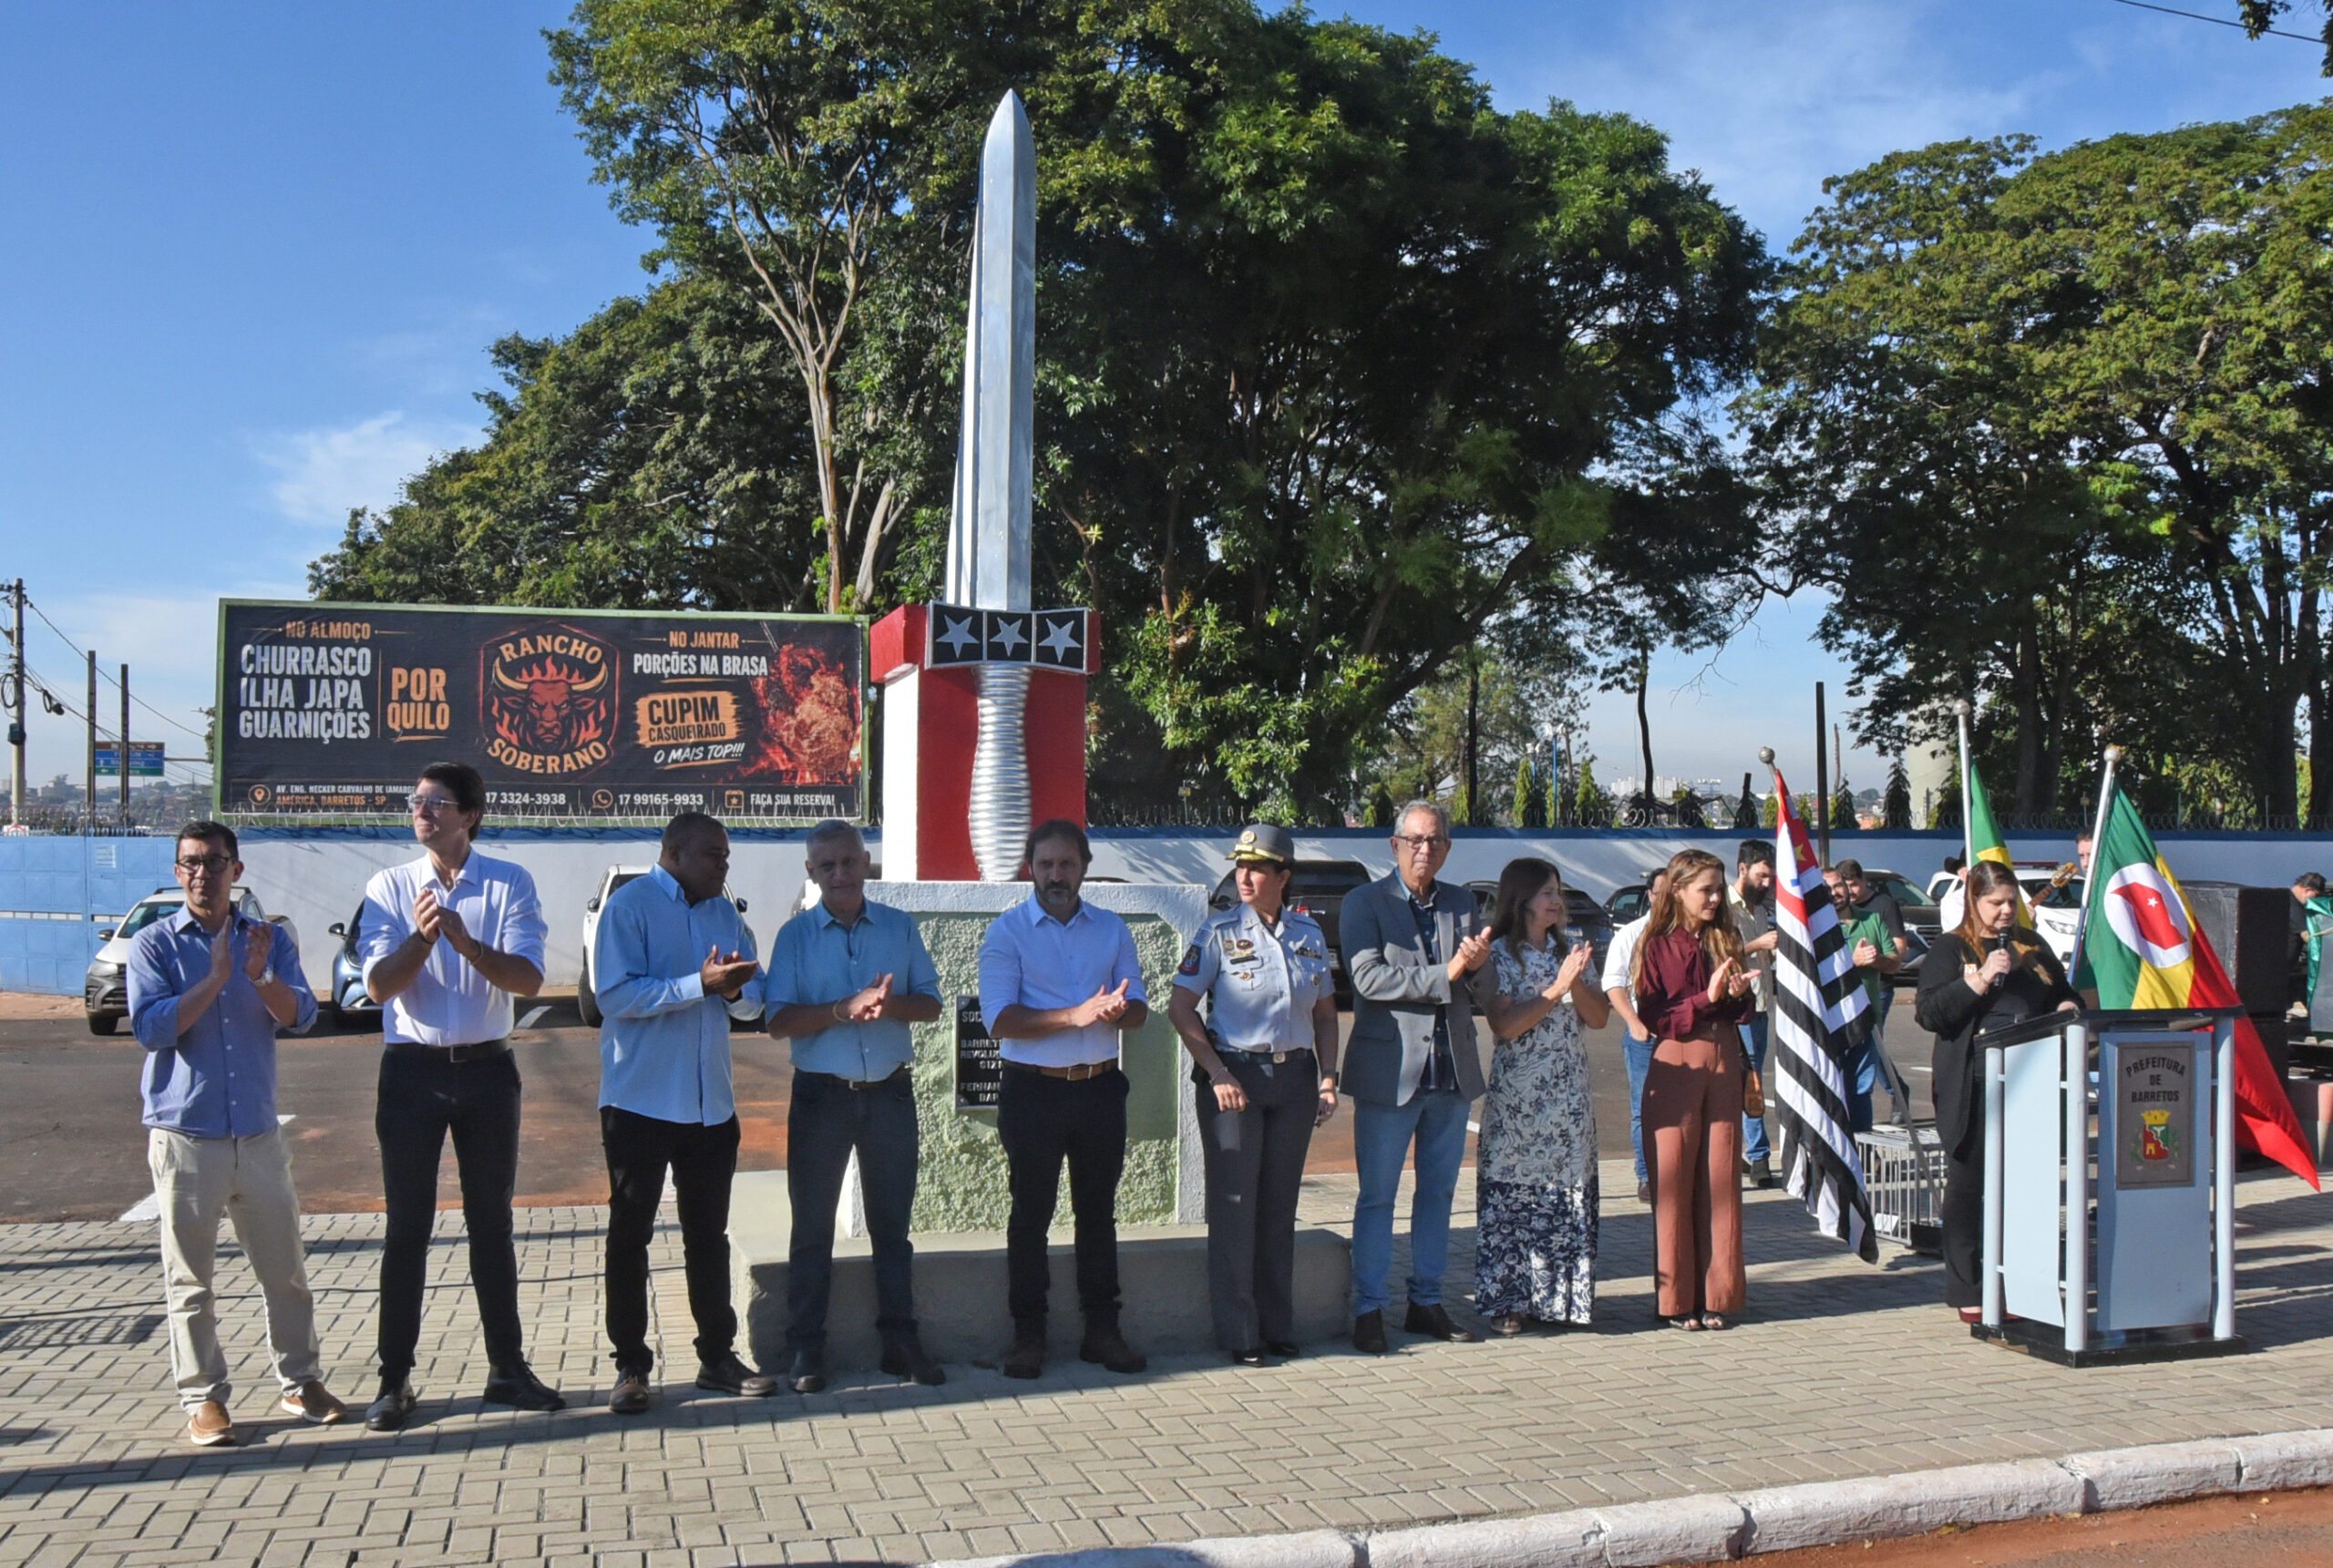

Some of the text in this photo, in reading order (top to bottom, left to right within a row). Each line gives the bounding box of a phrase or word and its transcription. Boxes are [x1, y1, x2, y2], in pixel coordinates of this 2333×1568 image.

[285, 620, 371, 643] NO ALMOÇO
[669, 631, 739, 649] NO JANTAR
[241, 644, 372, 676] CHURRASCO
[498, 635, 602, 664] RANCHO
[633, 651, 768, 678] PORÇÕES NA BRASA
[240, 677, 364, 709] ILHA JAPA
[391, 668, 447, 702] POR
[387, 702, 450, 733] QUILO
[648, 696, 720, 725] CUPIM
[239, 709, 371, 744] GUARNIÇÕES
[648, 723, 726, 743] CASQUEIRADO
[487, 738, 607, 774] SOBERANO
[653, 743, 745, 764] O MAIS TOP!!!
[321, 795, 365, 805] BARRETOS
[375, 795, 386, 805] SP
[337, 785, 373, 794] CARVALHO
[375, 785, 384, 794] DE
[485, 792, 566, 805] 17 3324-3938
[619, 794, 704, 806] 17 99165-9933
[750, 794, 835, 807] FAÇA SUA RESERVA!
[2125, 1057, 2185, 1078] PREFEITURA
[2149, 1074, 2162, 1086] DE
[2131, 1090, 2180, 1103] BARRETOS
